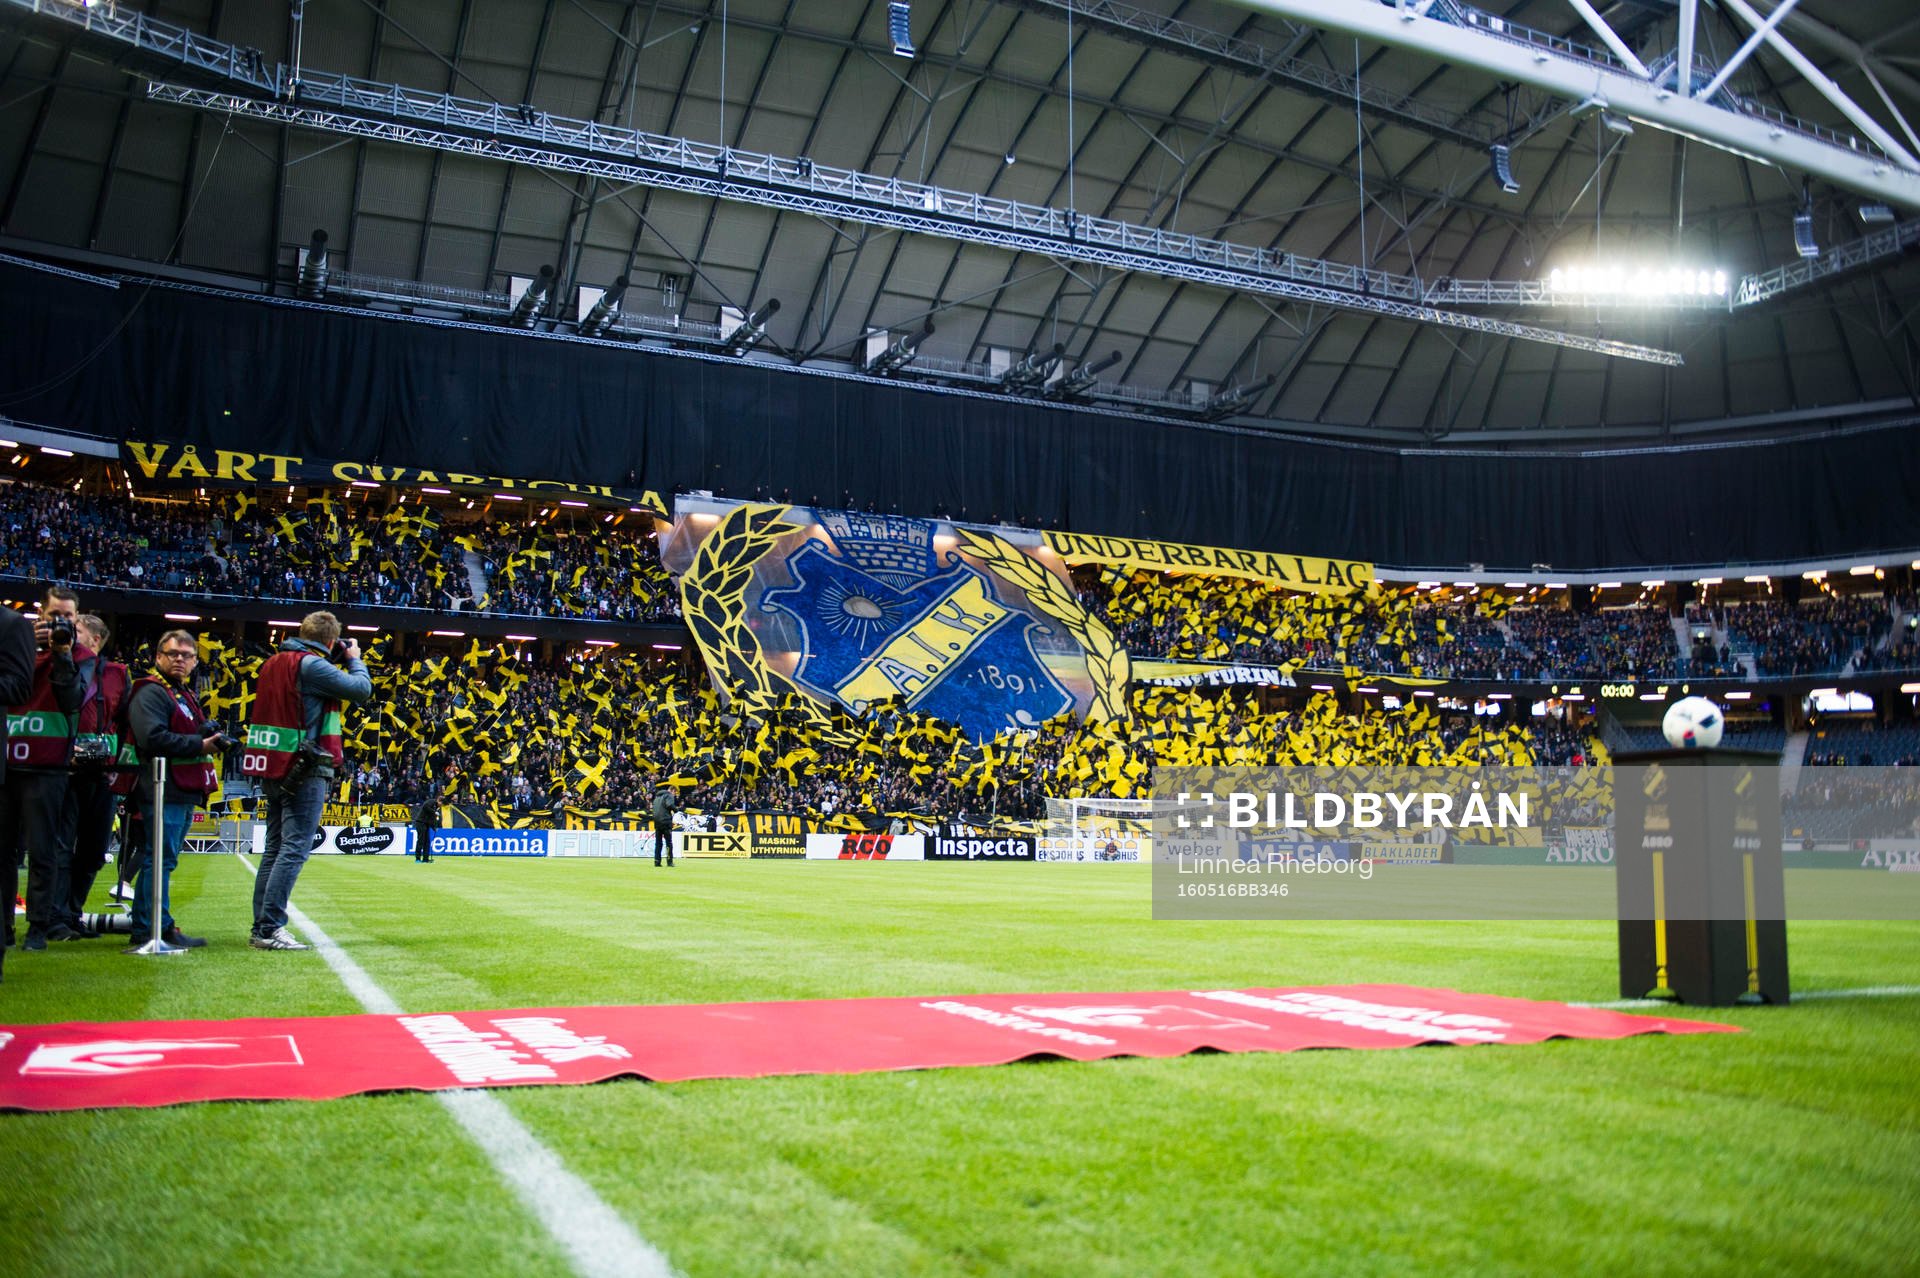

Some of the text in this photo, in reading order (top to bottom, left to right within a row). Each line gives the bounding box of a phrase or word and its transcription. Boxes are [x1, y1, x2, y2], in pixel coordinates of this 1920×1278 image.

[126, 441, 302, 482] VÅRT
[1046, 532, 1369, 590] UNDERBARA LAG
[1601, 684, 1635, 697] 00:00
[353, 826, 376, 836] Lars
[340, 834, 390, 846] Bengtsson
[683, 835, 746, 852] ITEX
[759, 837, 799, 845] MASKIN-
[842, 839, 892, 854] RCO
[935, 838, 1029, 857] Inspecta
[752, 847, 806, 855] UTHYRNING
[1168, 841, 1222, 856] weber
